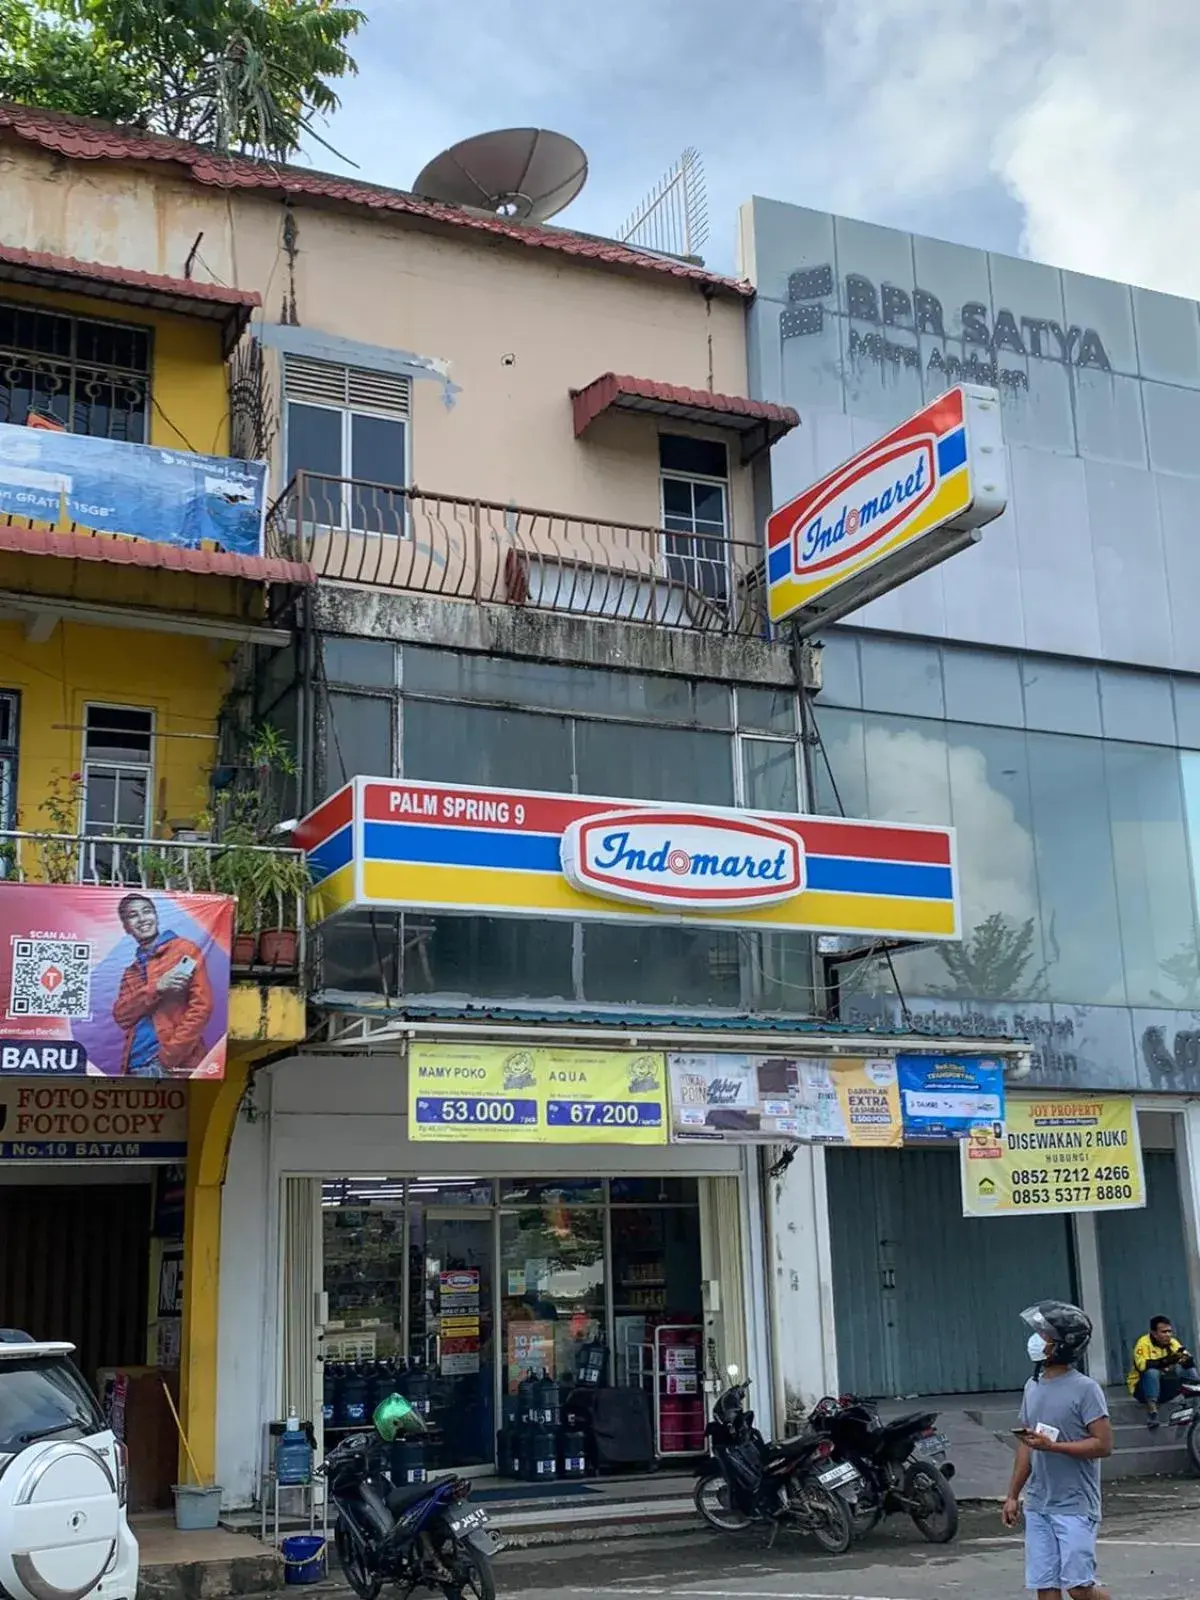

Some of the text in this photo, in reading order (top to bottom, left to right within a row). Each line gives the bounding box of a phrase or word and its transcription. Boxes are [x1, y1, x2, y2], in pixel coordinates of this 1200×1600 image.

[846, 273, 1111, 371] BPR SATYA
[802, 455, 926, 562] Indomaret
[389, 791, 526, 825] PALM SPRING 9
[594, 831, 788, 881] Indomaret
[29, 930, 78, 941] SCAN AJA
[2, 1046, 79, 1070] BARU
[419, 1066, 487, 1079] MAMY POKO
[549, 1071, 587, 1082] AQUA
[17, 1088, 185, 1111] FOTO STUDIO
[848, 1096, 889, 1107] EXTRA
[442, 1101, 515, 1122] 53.000
[571, 1104, 639, 1124] 67.200
[1028, 1103, 1104, 1118] JOY PROPERTY
[15, 1113, 90, 1135] FOTO
[93, 1113, 164, 1135] COPY
[12, 1143, 140, 1157] No.10 BATAM
[1008, 1130, 1128, 1150] DISEWAKAN 2 RUKO
[1045, 1153, 1089, 1164] HUBUNGI
[1011, 1166, 1130, 1185] 0852 7212 4266
[1012, 1185, 1132, 1204] 0853 5377 8880
